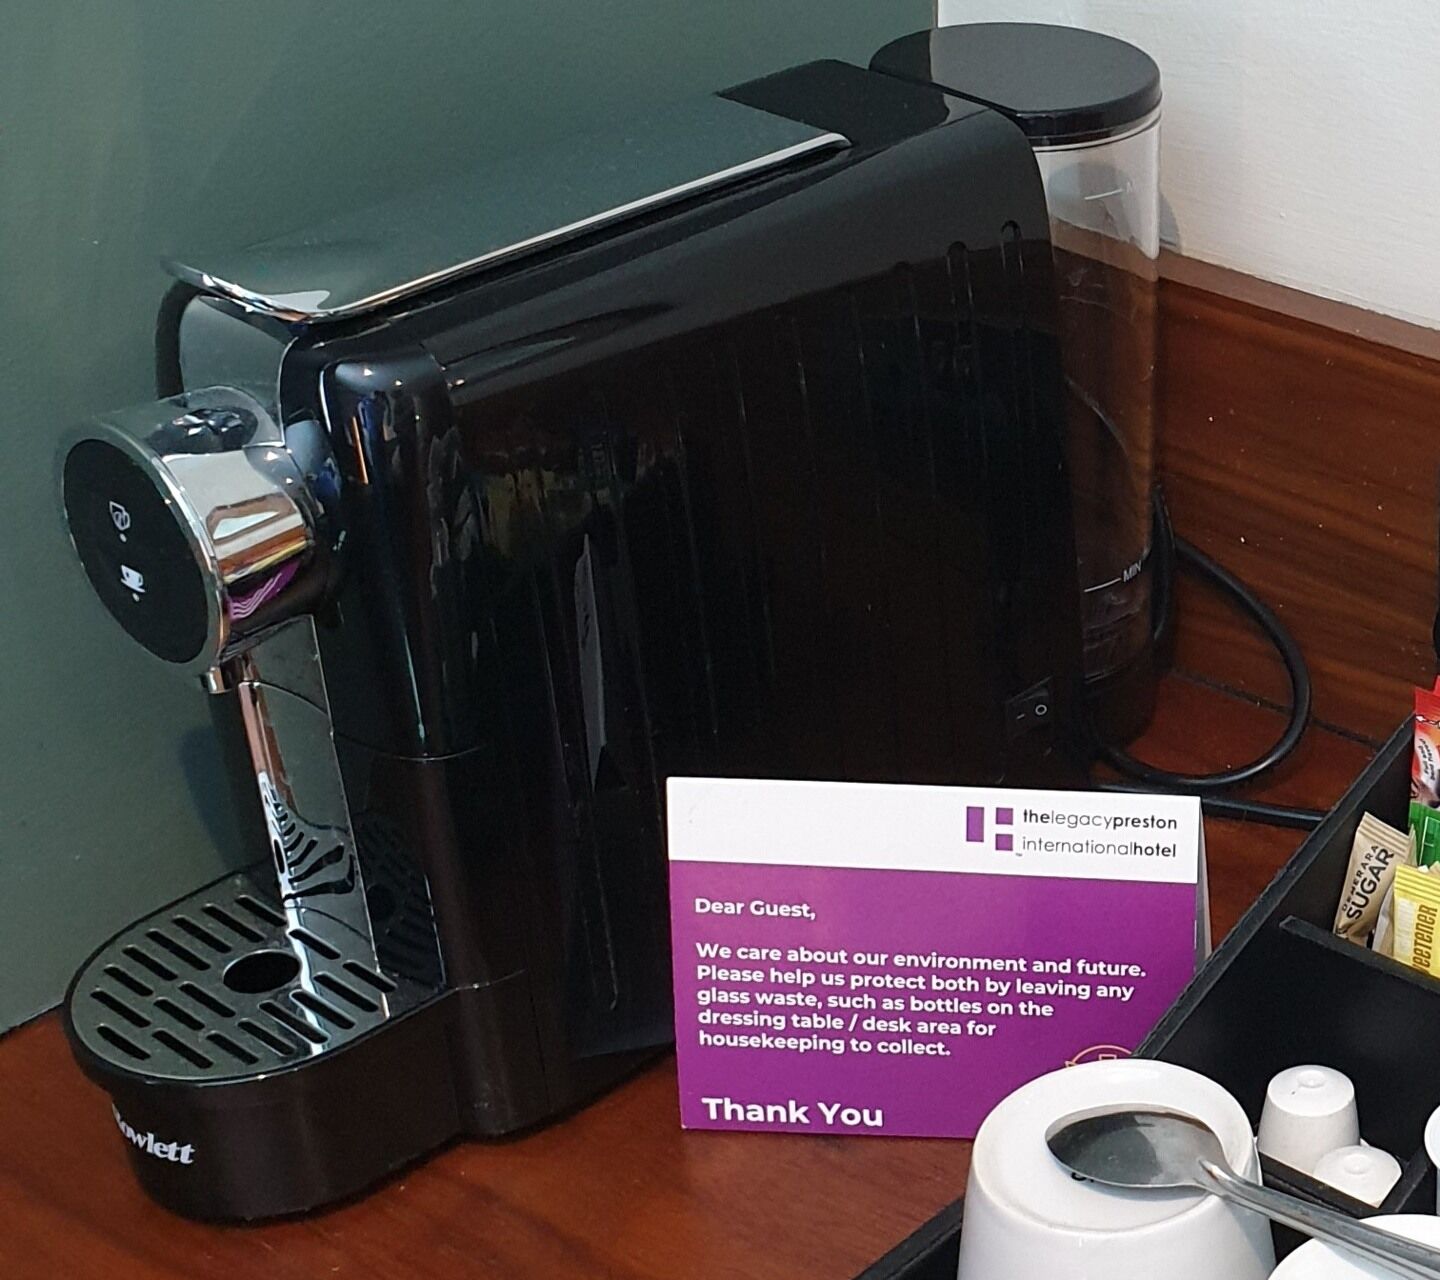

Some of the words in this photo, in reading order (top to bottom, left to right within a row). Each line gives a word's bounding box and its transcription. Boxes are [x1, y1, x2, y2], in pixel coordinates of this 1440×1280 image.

[1023, 809, 1177, 830] thelegacypreston
[1022, 836, 1177, 857] internationalhotel
[1346, 848, 1395, 920] SUGAR
[695, 898, 745, 915] Dear
[750, 900, 816, 920] Guest,
[696, 942, 732, 959] We
[736, 946, 782, 961] care
[787, 947, 848, 964] about
[853, 951, 889, 966] our
[893, 951, 1027, 972] environment
[1032, 958, 1072, 974] and
[1076, 958, 1146, 977] future.
[697, 965, 765, 982] Please
[769, 968, 816, 988] help
[821, 973, 845, 986] us
[850, 973, 926, 990] protect
[931, 975, 980, 992] both
[985, 977, 1011, 996] by
[1016, 978, 1091, 1000] leaving
[1096, 984, 1135, 1002] any
[697, 987, 751, 1006] glass
[755, 991, 823, 1010] waste,
[827, 993, 877, 1010] such
[882, 998, 905, 1011] as
[910, 996, 982, 1014] bottles
[987, 1001, 1014, 1015] on
[1018, 1001, 1055, 1017] the
[698, 1009, 787, 1031] dressing
[791, 1013, 845, 1030] table
[849, 1013, 859, 1032] /
[862, 1016, 912, 1033] desk
[917, 1021, 962, 1035] area
[966, 1020, 997, 1036] for
[699, 1030, 845, 1054] housekeeping
[850, 1036, 872, 1052] to
[877, 1038, 951, 1056] collect.
[701, 1097, 811, 1124] Thank
[816, 1102, 884, 1127] You
